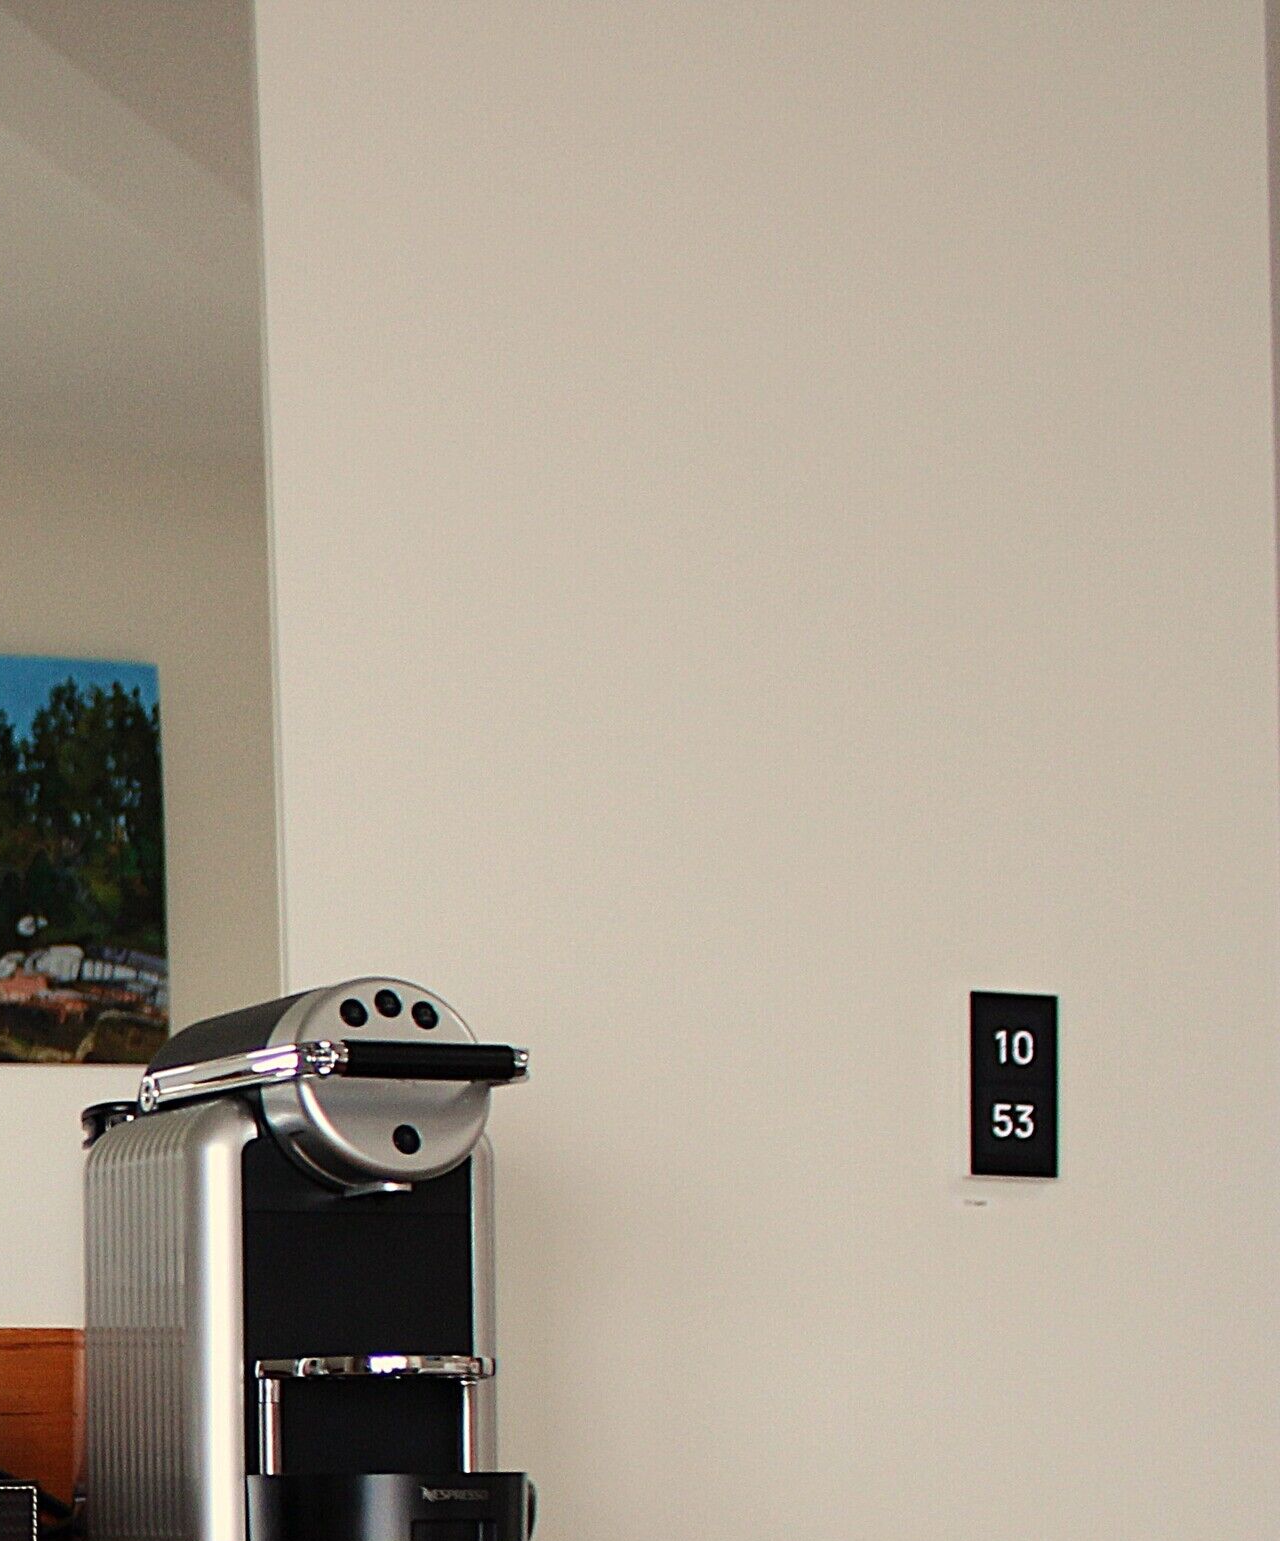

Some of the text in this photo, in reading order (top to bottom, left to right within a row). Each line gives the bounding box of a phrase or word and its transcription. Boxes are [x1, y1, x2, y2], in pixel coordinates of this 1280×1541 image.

[994, 1029, 1035, 1065] 10
[991, 1103, 1035, 1139] 53
[420, 1486, 489, 1503] NESPRESSO
